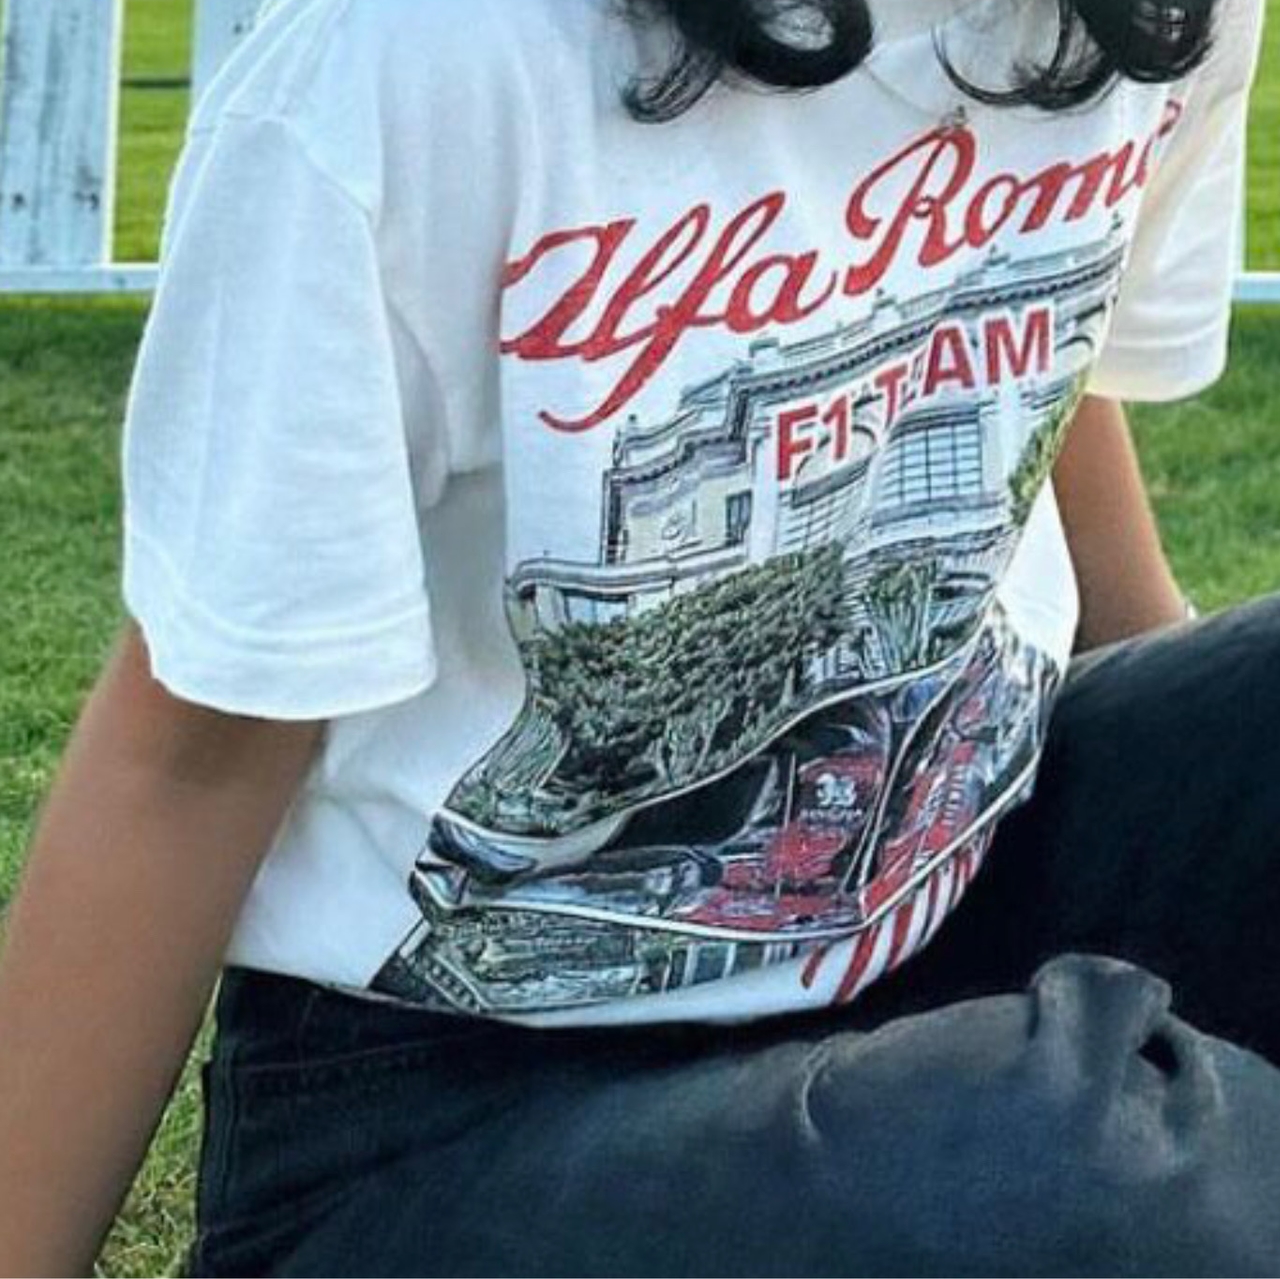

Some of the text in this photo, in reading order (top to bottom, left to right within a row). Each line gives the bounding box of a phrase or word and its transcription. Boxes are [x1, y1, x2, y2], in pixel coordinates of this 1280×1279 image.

[498, 98, 1182, 432] Alfa Rom
[777, 306, 1051, 481] F1 TAM
